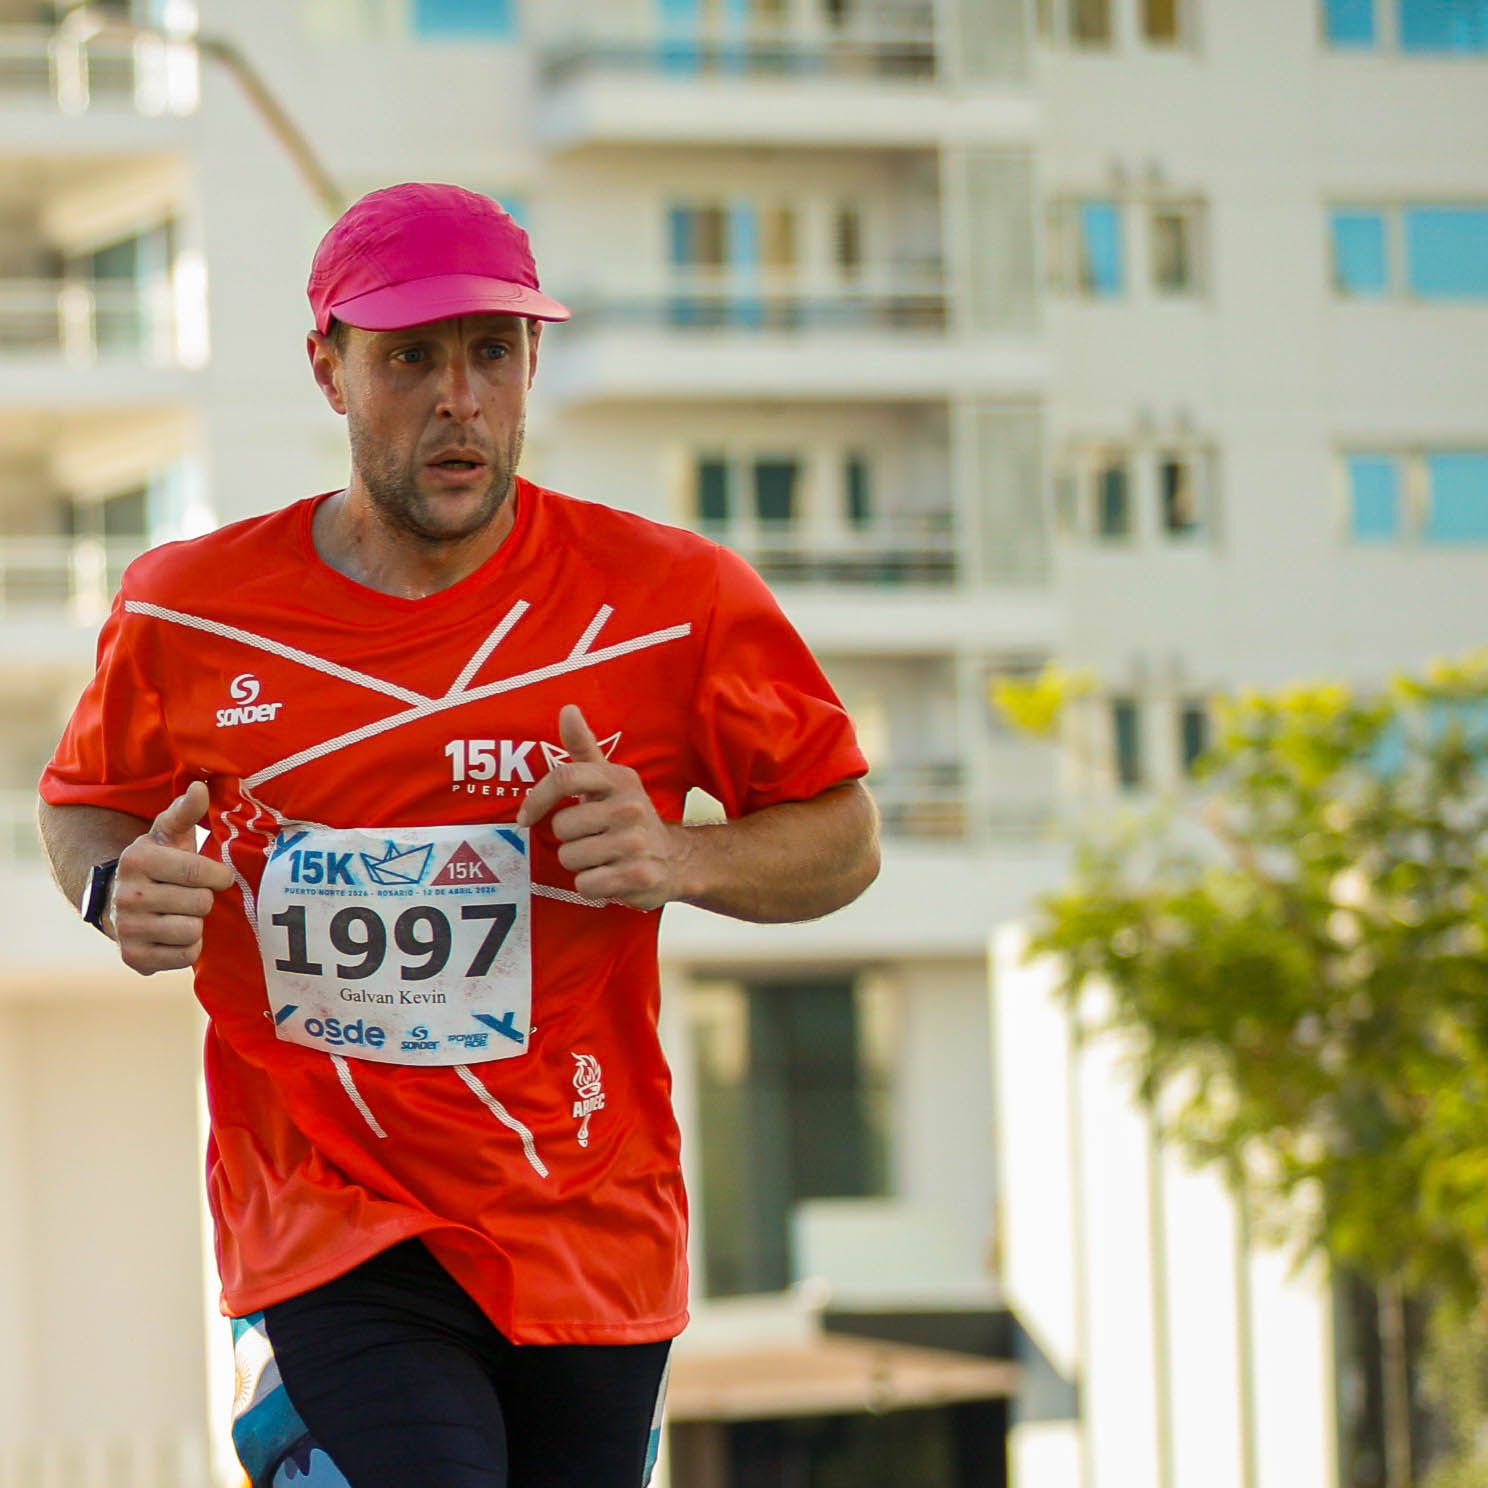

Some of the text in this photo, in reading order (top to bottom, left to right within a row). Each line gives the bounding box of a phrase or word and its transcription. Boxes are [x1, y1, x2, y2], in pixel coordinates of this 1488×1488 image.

[444, 739, 537, 783] 15K
[288, 850, 356, 886] 15K
[446, 861, 484, 880] 15K
[284, 887, 317, 896] PUERTO
[318, 889, 345, 897] NORTE
[377, 889, 414, 897] ROSARIO
[435, 888, 446, 896] DE
[448, 887, 473, 895] ABRIL
[271, 902, 518, 981] 1997
[340, 987, 448, 1005] Galvan Kevin
[304, 1017, 386, 1047] osde
